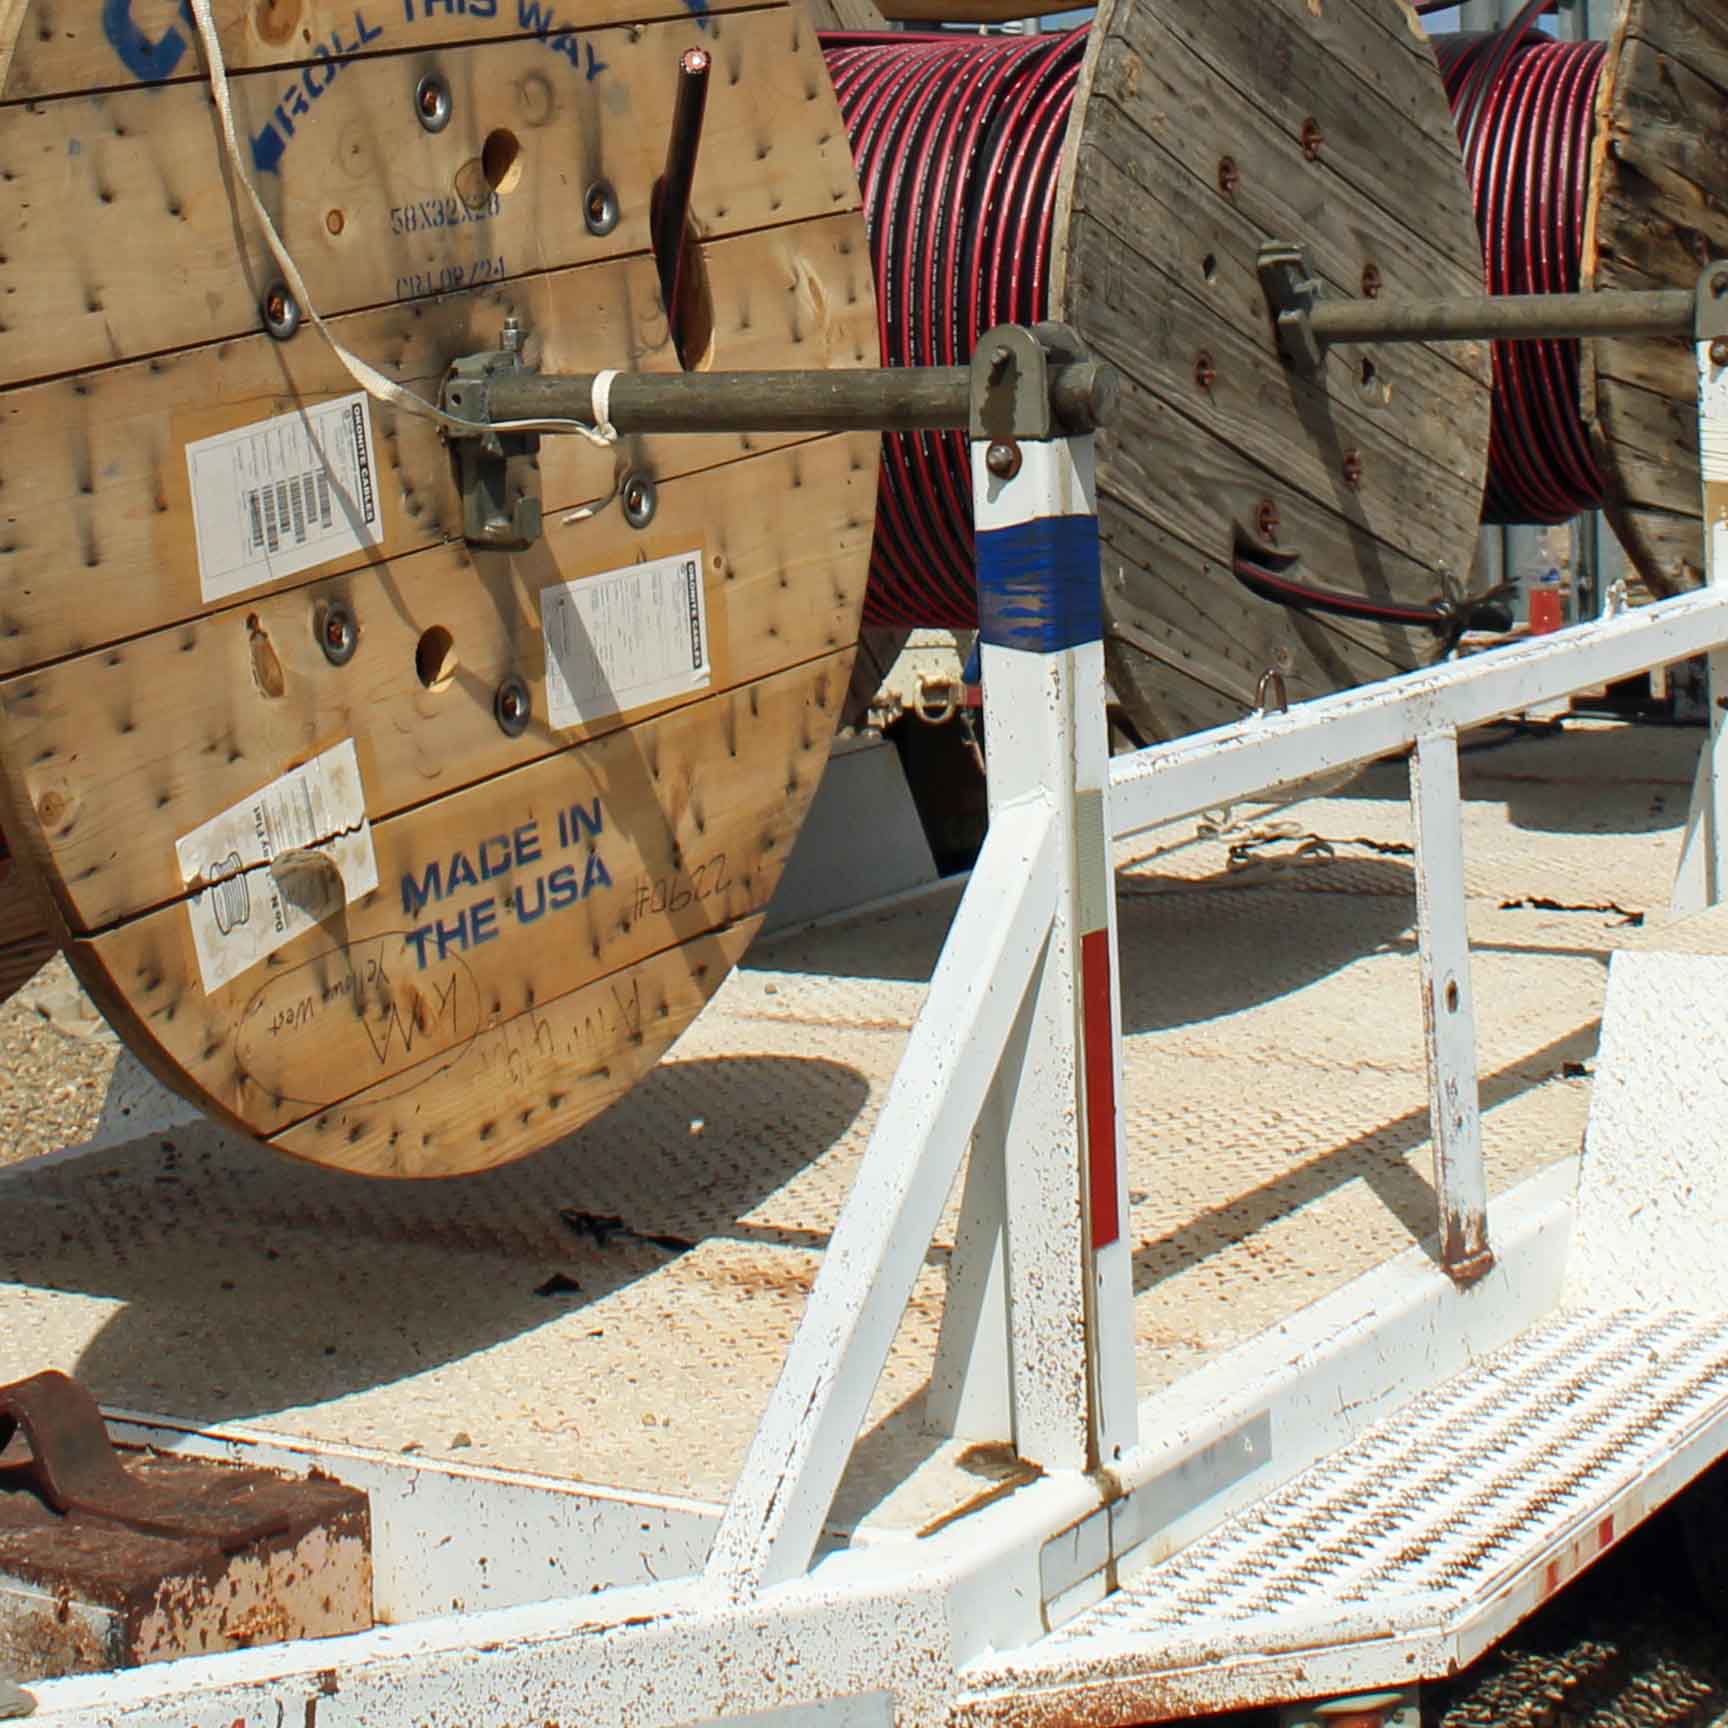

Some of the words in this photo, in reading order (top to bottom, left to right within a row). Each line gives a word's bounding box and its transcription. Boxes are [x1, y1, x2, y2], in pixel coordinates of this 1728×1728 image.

[273, 9, 384, 140] ROLL
[353, 405, 367, 465] OKONITE
[360, 466, 375, 522] CABLES
[401, 821, 543, 915] MADE
[558, 796, 604, 849] IN
[404, 897, 501, 970] THE
[514, 851, 614, 926] USA
